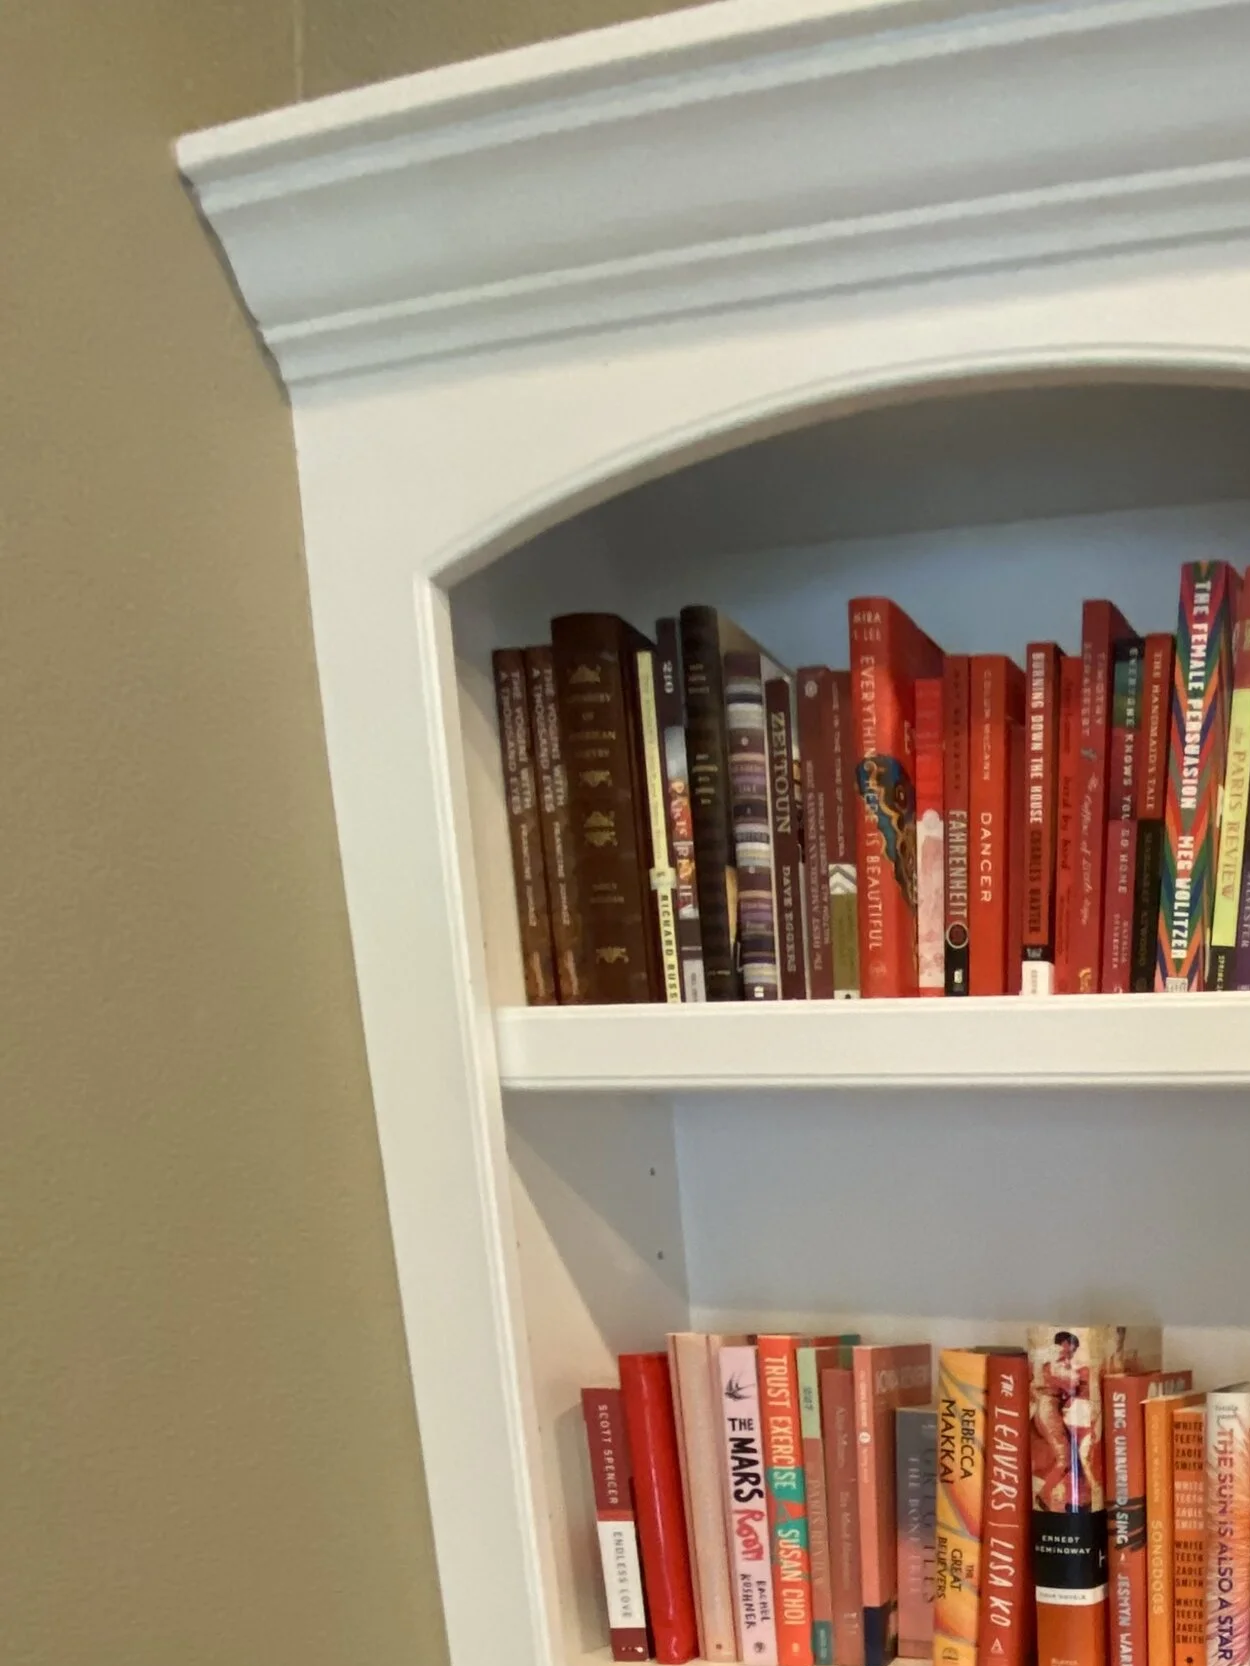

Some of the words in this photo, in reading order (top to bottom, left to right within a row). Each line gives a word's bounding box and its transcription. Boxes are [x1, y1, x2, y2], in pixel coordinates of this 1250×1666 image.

[1192, 580, 1212, 617] THE
[1152, 652, 1163, 679] THE
[1188, 622, 1209, 692] FEMALE
[1031, 651, 1046, 709] BURNING
[1030, 714, 1045, 752] DOWN
[1180, 697, 1204, 809] PERSUASION
[771, 711, 792, 834] ZEITOUN
[1030, 756, 1044, 780] THE
[1122, 733, 1134, 788] KNOWS
[1229, 750, 1247, 815] PARIS
[1029, 785, 1043, 825] HOUSE
[1121, 795, 1132, 826] YOU
[864, 831, 876, 847] IS
[980, 812, 993, 903] DANCER
[1176, 835, 1195, 871] MEG
[948, 810, 968, 918] FAHRENHEIT
[1117, 853, 1129, 895] HOME
[1221, 821, 1241, 899] REVIEW
[782, 865, 794, 907] DAVE
[866, 854, 884, 950] BEAUTIFUL
[660, 894, 674, 956] RICHARD
[1171, 877, 1192, 960] WOLITZER
[783, 911, 797, 973] EGGERS
[763, 1354, 791, 1409] TRUST
[1000, 1373, 1016, 1398] THE
[598, 1404, 612, 1444] SCOTT
[727, 1417, 754, 1431] THE
[940, 1399, 957, 1485] MAKKAI
[1174, 1421, 1204, 1432] WHITE
[1174, 1433, 1204, 1445] TEETH
[769, 1415, 797, 1490] EXERCISE
[959, 1408, 976, 1481] REBECCA
[990, 1406, 1020, 1513] LEAVERS
[1174, 1448, 1204, 1459] ZADIE
[1217, 1428, 1235, 1469] THE
[603, 1446, 619, 1505] SPENCER
[729, 1437, 764, 1504] MARS
[907, 1457, 921, 1489] THE
[1174, 1460, 1204, 1472] SMITH
[1174, 1481, 1204, 1491] WHITE
[1174, 1493, 1204, 1504] TEETH
[1174, 1506, 1204, 1518] ZADIE
[1217, 1473, 1235, 1517] SUN
[1041, 1534, 1080, 1544] ERNEST
[1115, 1511, 1129, 1545] SING
[1174, 1519, 1204, 1530] SMITH
[1217, 1520, 1235, 1539] IS
[612, 1531, 628, 1585] ENDLESS
[777, 1527, 802, 1582] SUSAN
[987, 1537, 1016, 1588] LISA
[1034, 1545, 1091, 1555] HEMINGWAY
[1174, 1540, 1204, 1551] WHITE
[1174, 1552, 1204, 1563] TEETH
[935, 1537, 949, 1600] BELIEVERS
[949, 1547, 963, 1592] GREAT
[1150, 1519, 1164, 1616] SONGDOGS
[1174, 1566, 1204, 1577] ZADIE
[1174, 1578, 1204, 1589] SMITH
[1216, 1542, 1234, 1594] ALSO
[618, 1588, 633, 1618] LOVE
[740, 1573, 757, 1630] KUSHNER
[756, 1580, 771, 1623] RACHEL
[781, 1588, 806, 1626] CHOI
[988, 1595, 1013, 1628] KO
[1116, 1573, 1132, 1628] JESMYN
[1175, 1598, 1204, 1608] WHITE
[1175, 1610, 1204, 1620] TEETH
[1217, 1596, 1233, 1611] A
[1175, 1622, 1204, 1633] ZADIE
[1175, 1635, 1204, 1645] SMITH
[1217, 1618, 1234, 1662] STAR
